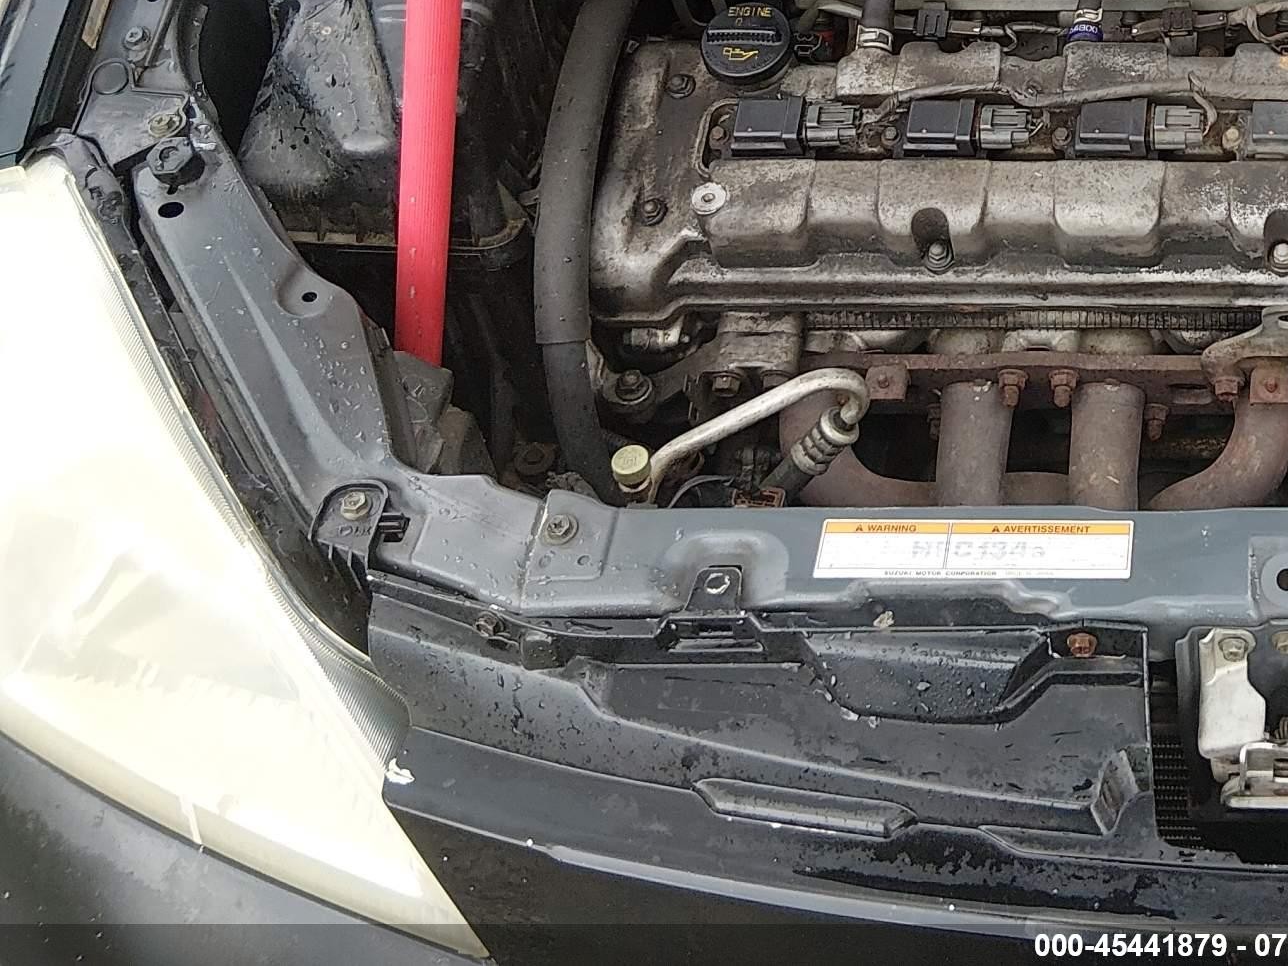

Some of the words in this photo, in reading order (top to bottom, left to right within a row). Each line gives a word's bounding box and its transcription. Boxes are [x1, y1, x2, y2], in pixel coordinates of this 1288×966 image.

[727, 6, 773, 18] ENGINE
[867, 524, 918, 533] WARNING
[1003, 525, 1091, 534] AVERTISSEMENT
